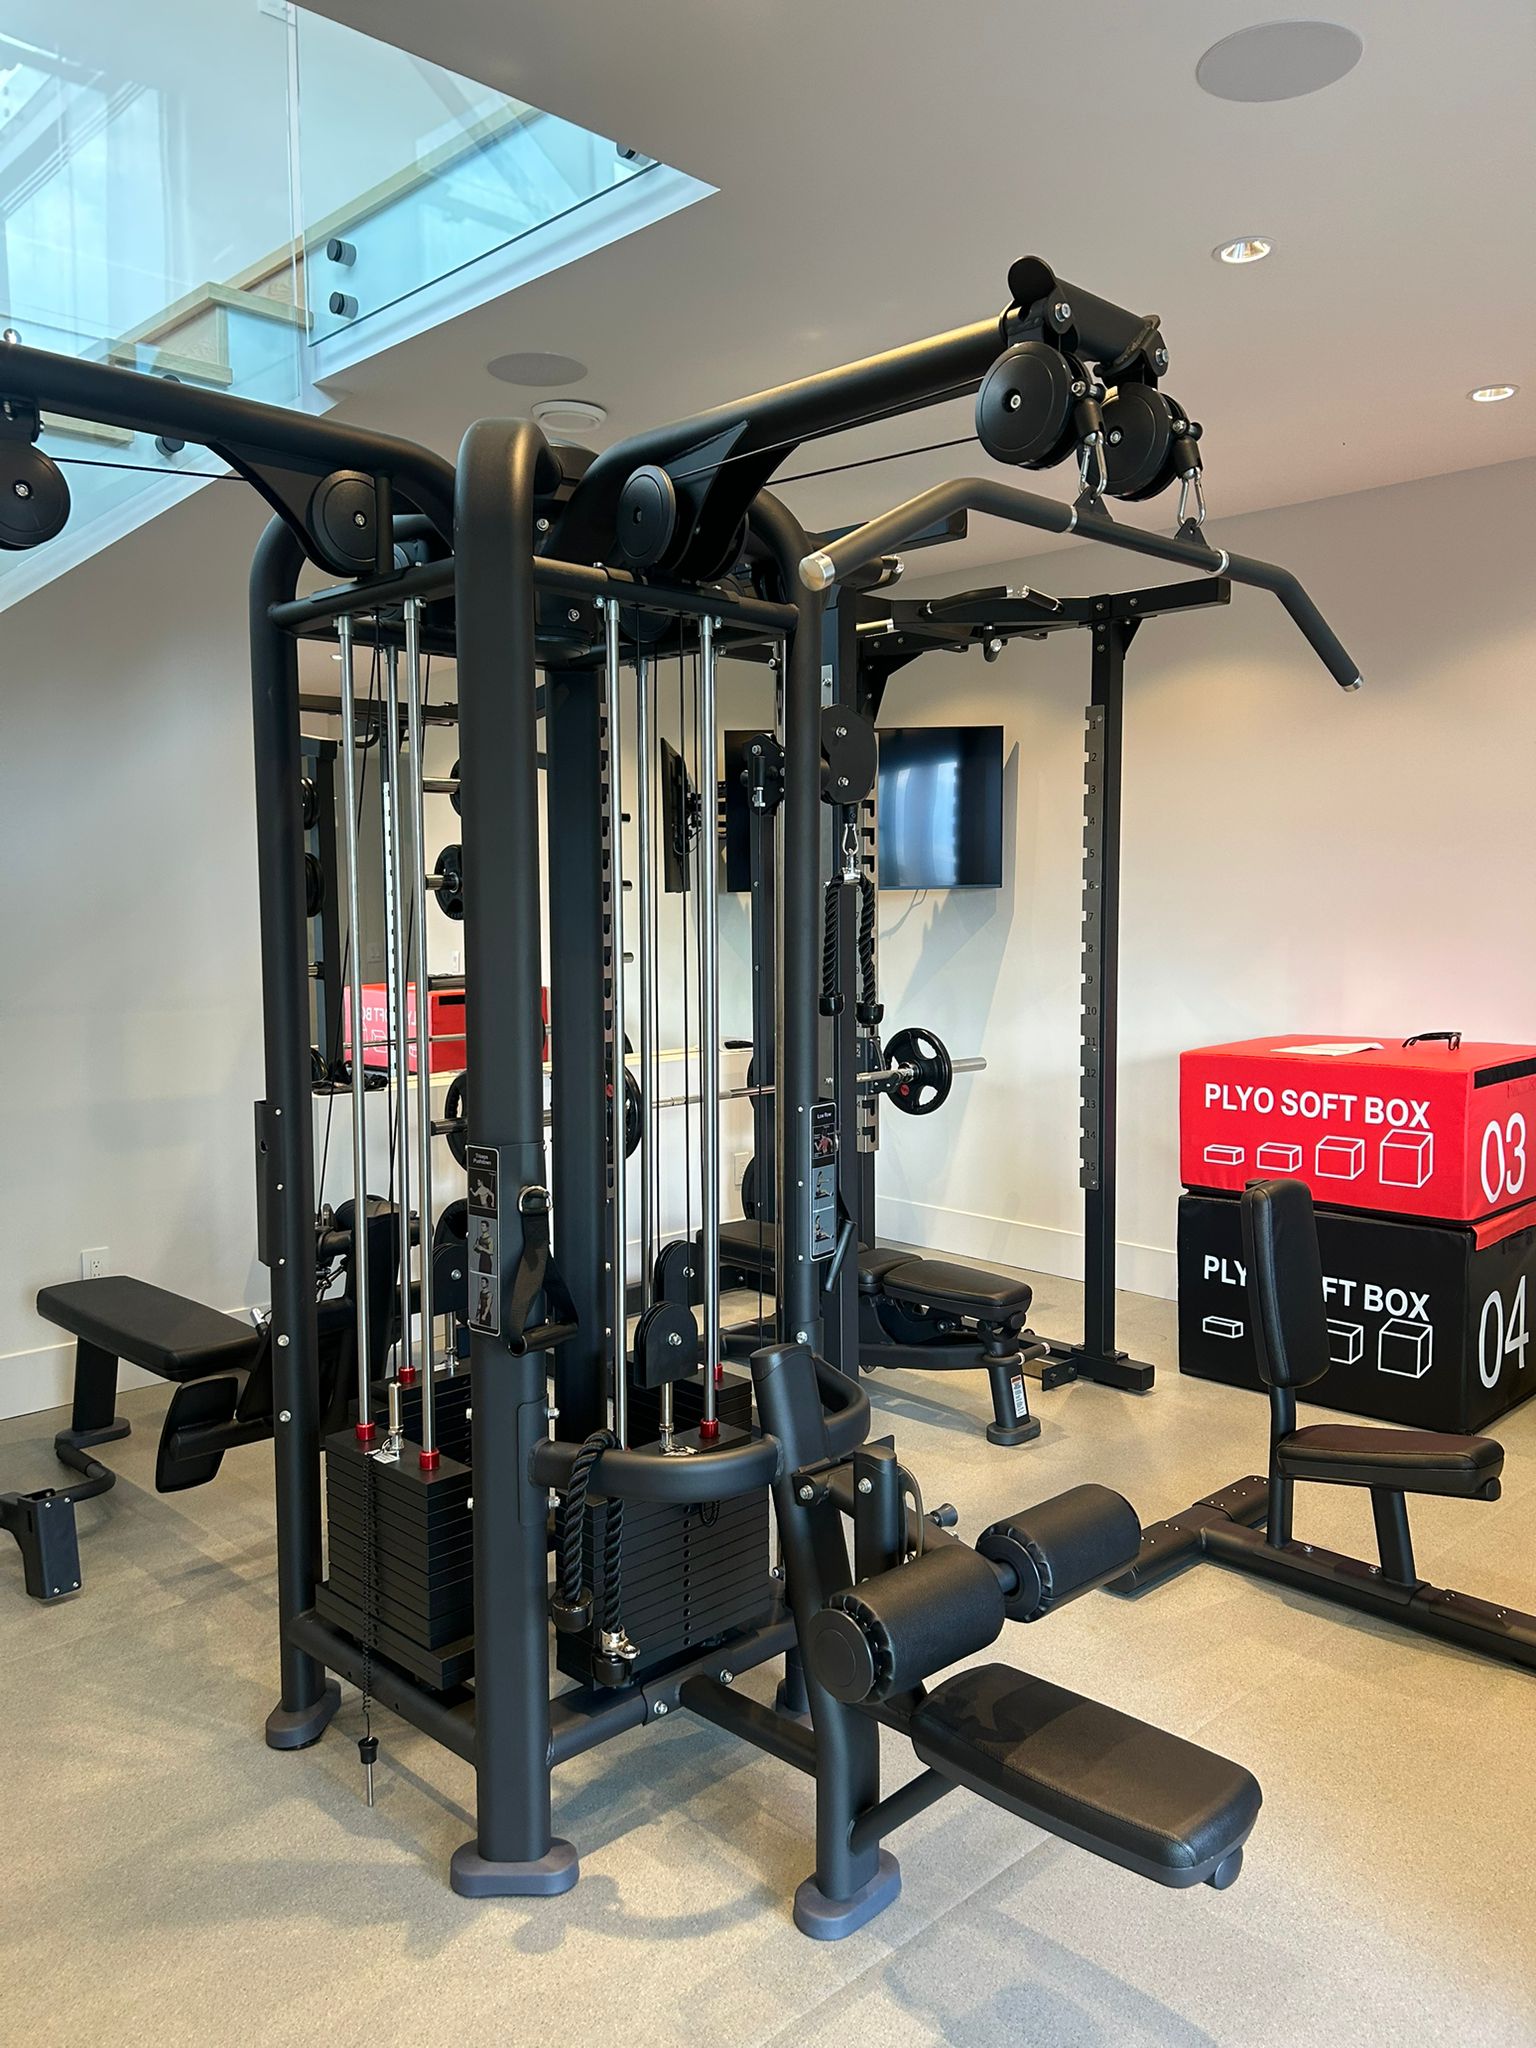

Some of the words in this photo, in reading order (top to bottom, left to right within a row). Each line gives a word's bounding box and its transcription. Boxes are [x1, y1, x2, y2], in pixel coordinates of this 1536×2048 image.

[1089, 720, 1096, 730] 1
[1090, 752, 1097, 762] 2
[1091, 784, 1097, 794] 3
[1089, 816, 1095, 826] 4
[1089, 848, 1095, 858] 5
[1088, 880, 1095, 890] 6
[1088, 912, 1094, 921] 7
[1088, 944, 1094, 953] 8
[1087, 975, 1093, 985] 9
[1086, 1006, 1097, 1016] 10
[1086, 1037, 1096, 1046] 11
[1086, 1069, 1096, 1078] 12
[1086, 1099, 1097, 1109] 13
[1204, 1082, 1275, 1114] PLYO
[1280, 1088, 1358, 1123] SOFT
[1364, 1096, 1431, 1129] BOX
[1086, 1129, 1096, 1139] 14
[1480, 1112, 1527, 1204] 03
[1086, 1161, 1096, 1171] 15
[1203, 1254, 1248, 1287] PLY
[1322, 1275, 1358, 1308] FT
[1363, 1283, 1431, 1322] BOX
[1479, 1274, 1530, 1389] 04
